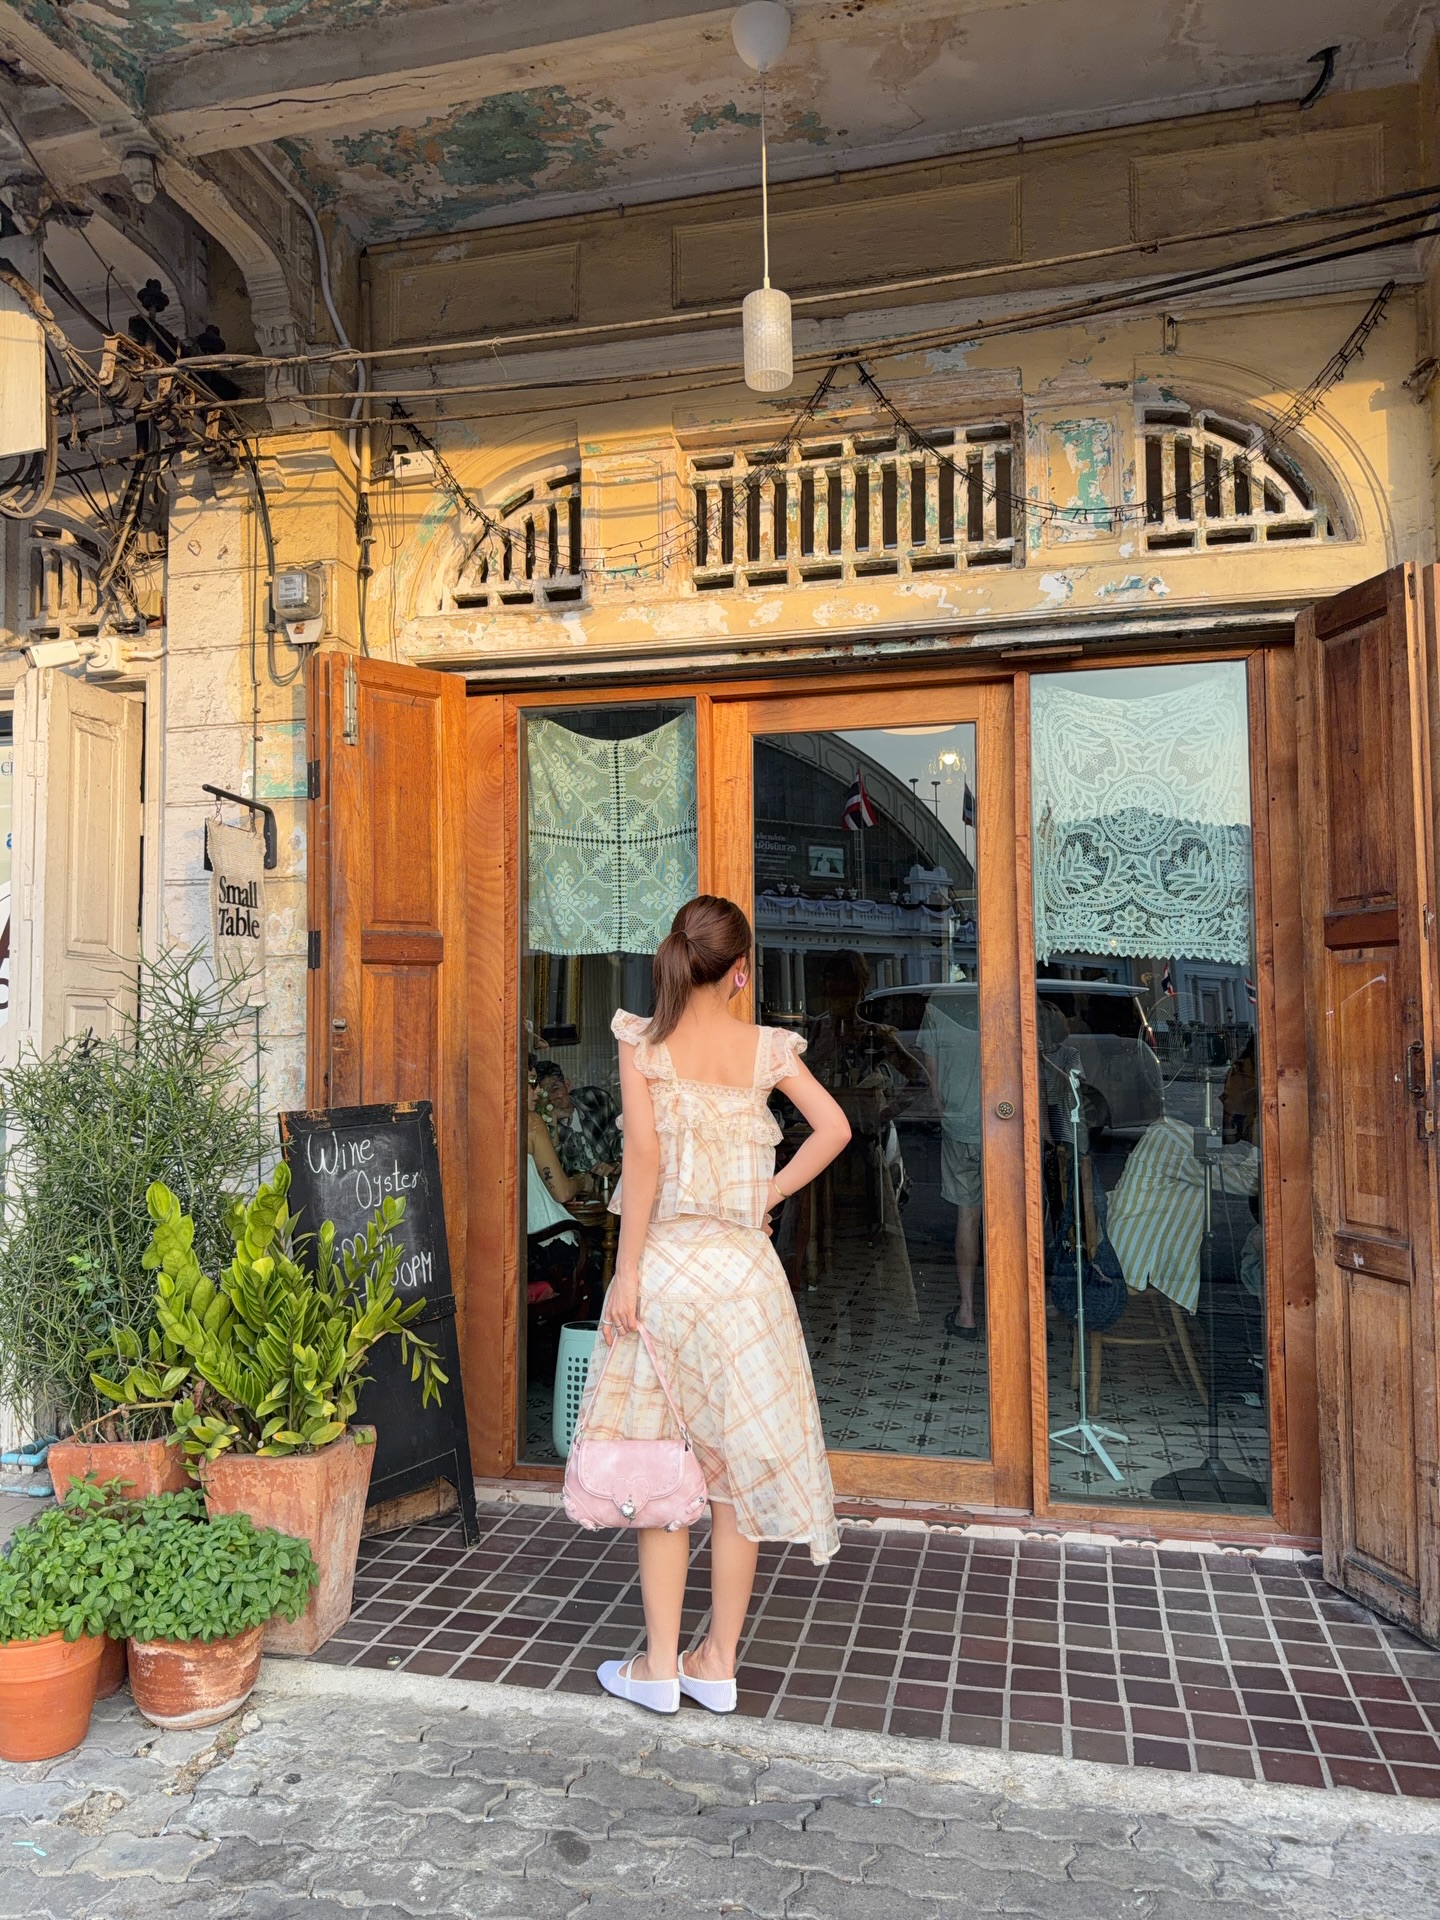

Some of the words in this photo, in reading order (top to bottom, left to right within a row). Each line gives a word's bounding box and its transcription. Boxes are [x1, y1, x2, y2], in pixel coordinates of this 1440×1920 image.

[218, 875, 258, 909] Small
[218, 906, 260, 940] Table
[307, 1131, 374, 1174] Wine
[355, 1159, 419, 1209] Oyster
